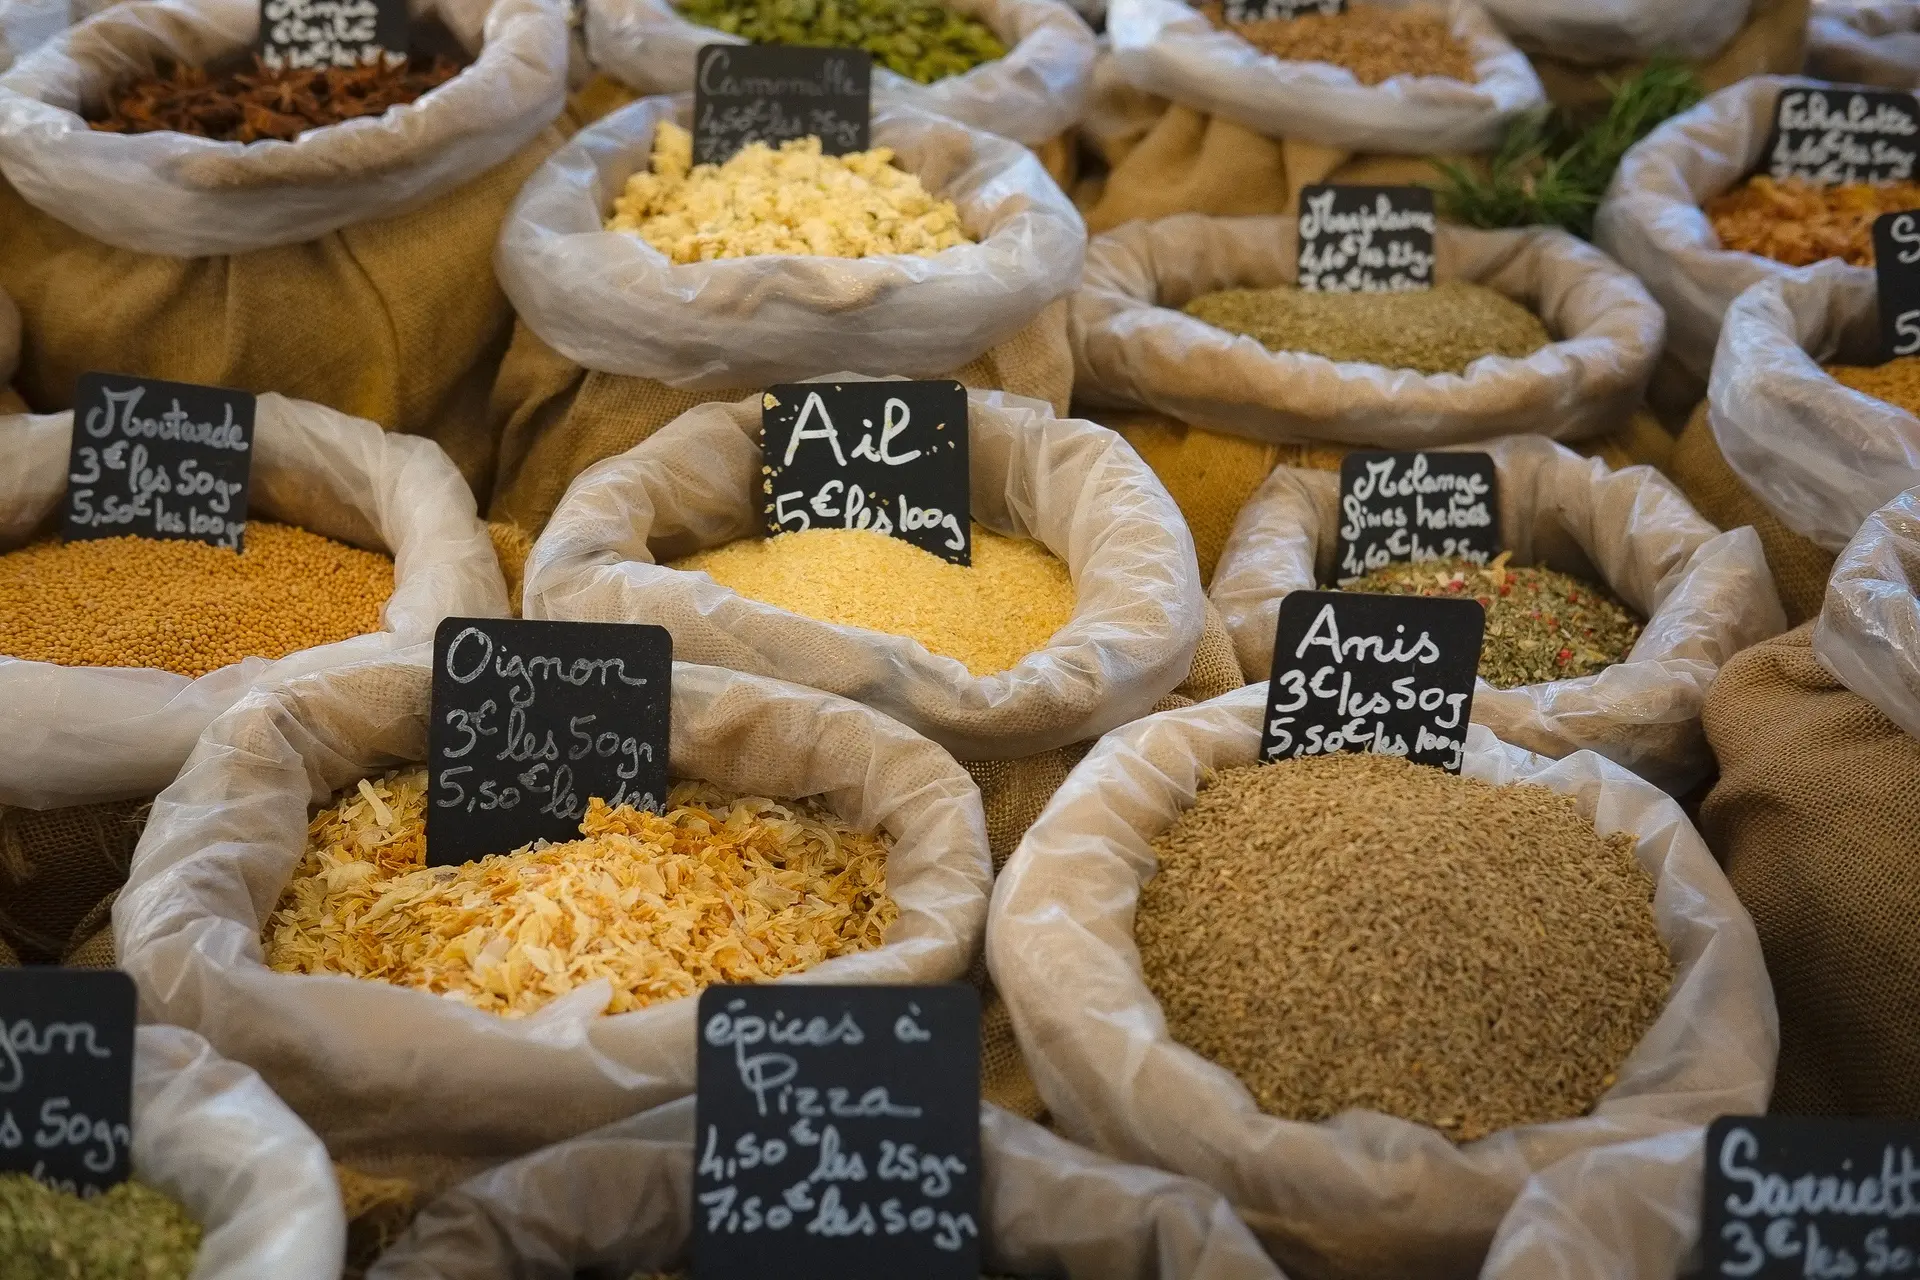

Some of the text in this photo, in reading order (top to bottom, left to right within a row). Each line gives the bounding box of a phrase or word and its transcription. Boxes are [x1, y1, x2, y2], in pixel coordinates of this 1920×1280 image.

[86, 386, 249, 451] Moutarde
[784, 391, 921, 466] Ail
[70, 440, 130, 484] 3€
[128, 443, 171, 494] les
[1353, 453, 1490, 506] Mélange
[154, 497, 187, 533] les
[776, 480, 966, 551] 5€ les 100g
[1341, 494, 1408, 541] fines
[1295, 603, 1440, 664] Anis
[446, 627, 648, 708] Oignon
[1275, 666, 1468, 729] 3€ les 50g
[443, 700, 653, 780] 3€ les 50gr
[1267, 717, 1375, 758] 5,50€
[1372, 721, 1409, 756] les
[436, 763, 551, 813] 5,50€
[540, 764, 584, 819] le
[705, 999, 932, 1070] épices à
[741, 1053, 923, 1117] Pizza
[699, 1118, 968, 1198] 4,50€ les 25gr
[1719, 1127, 1920, 1219] Sarriett
[699, 1180, 979, 1251] 7,50€ les 50gr
[1720, 1217, 1802, 1277] 3€
[1802, 1221, 1859, 1280] les
